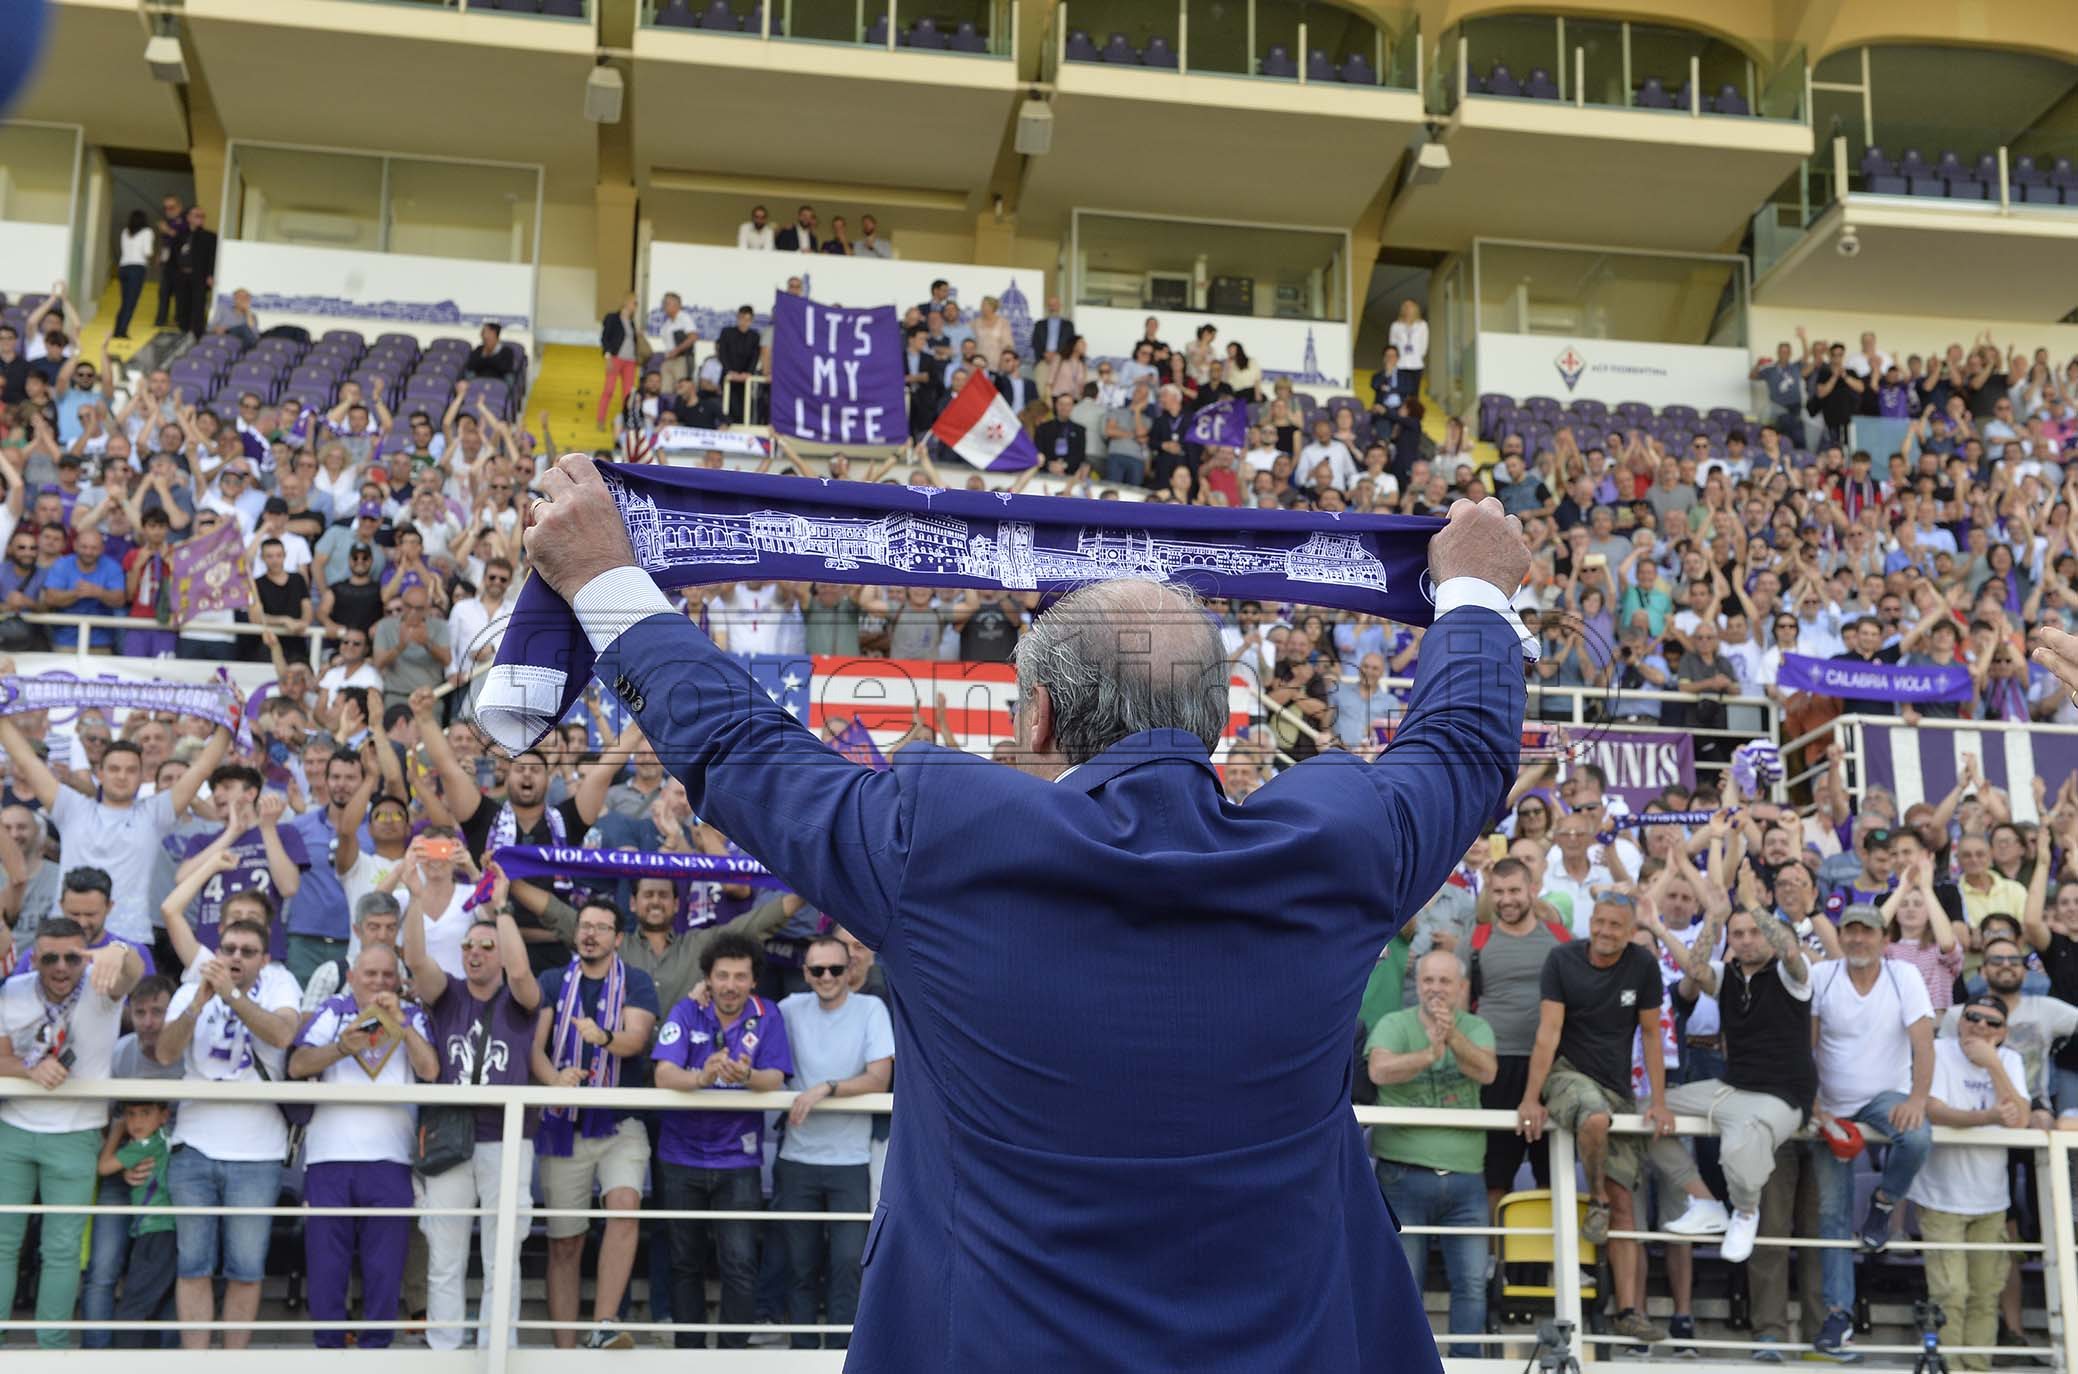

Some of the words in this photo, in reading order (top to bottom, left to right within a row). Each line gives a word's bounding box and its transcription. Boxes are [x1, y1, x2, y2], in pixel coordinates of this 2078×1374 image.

[805, 305, 874, 357] IT'S
[812, 354, 861, 402] MY
[794, 397, 887, 445] LIFE
[1825, 668, 1889, 691] CALABRIA
[1893, 675, 1932, 692] VIOLA
[1639, 812, 1713, 825] FIORENTIN
[538, 847, 604, 864] VIOLA
[609, 851, 664, 867] CLUB
[669, 856, 717, 870] NEW
